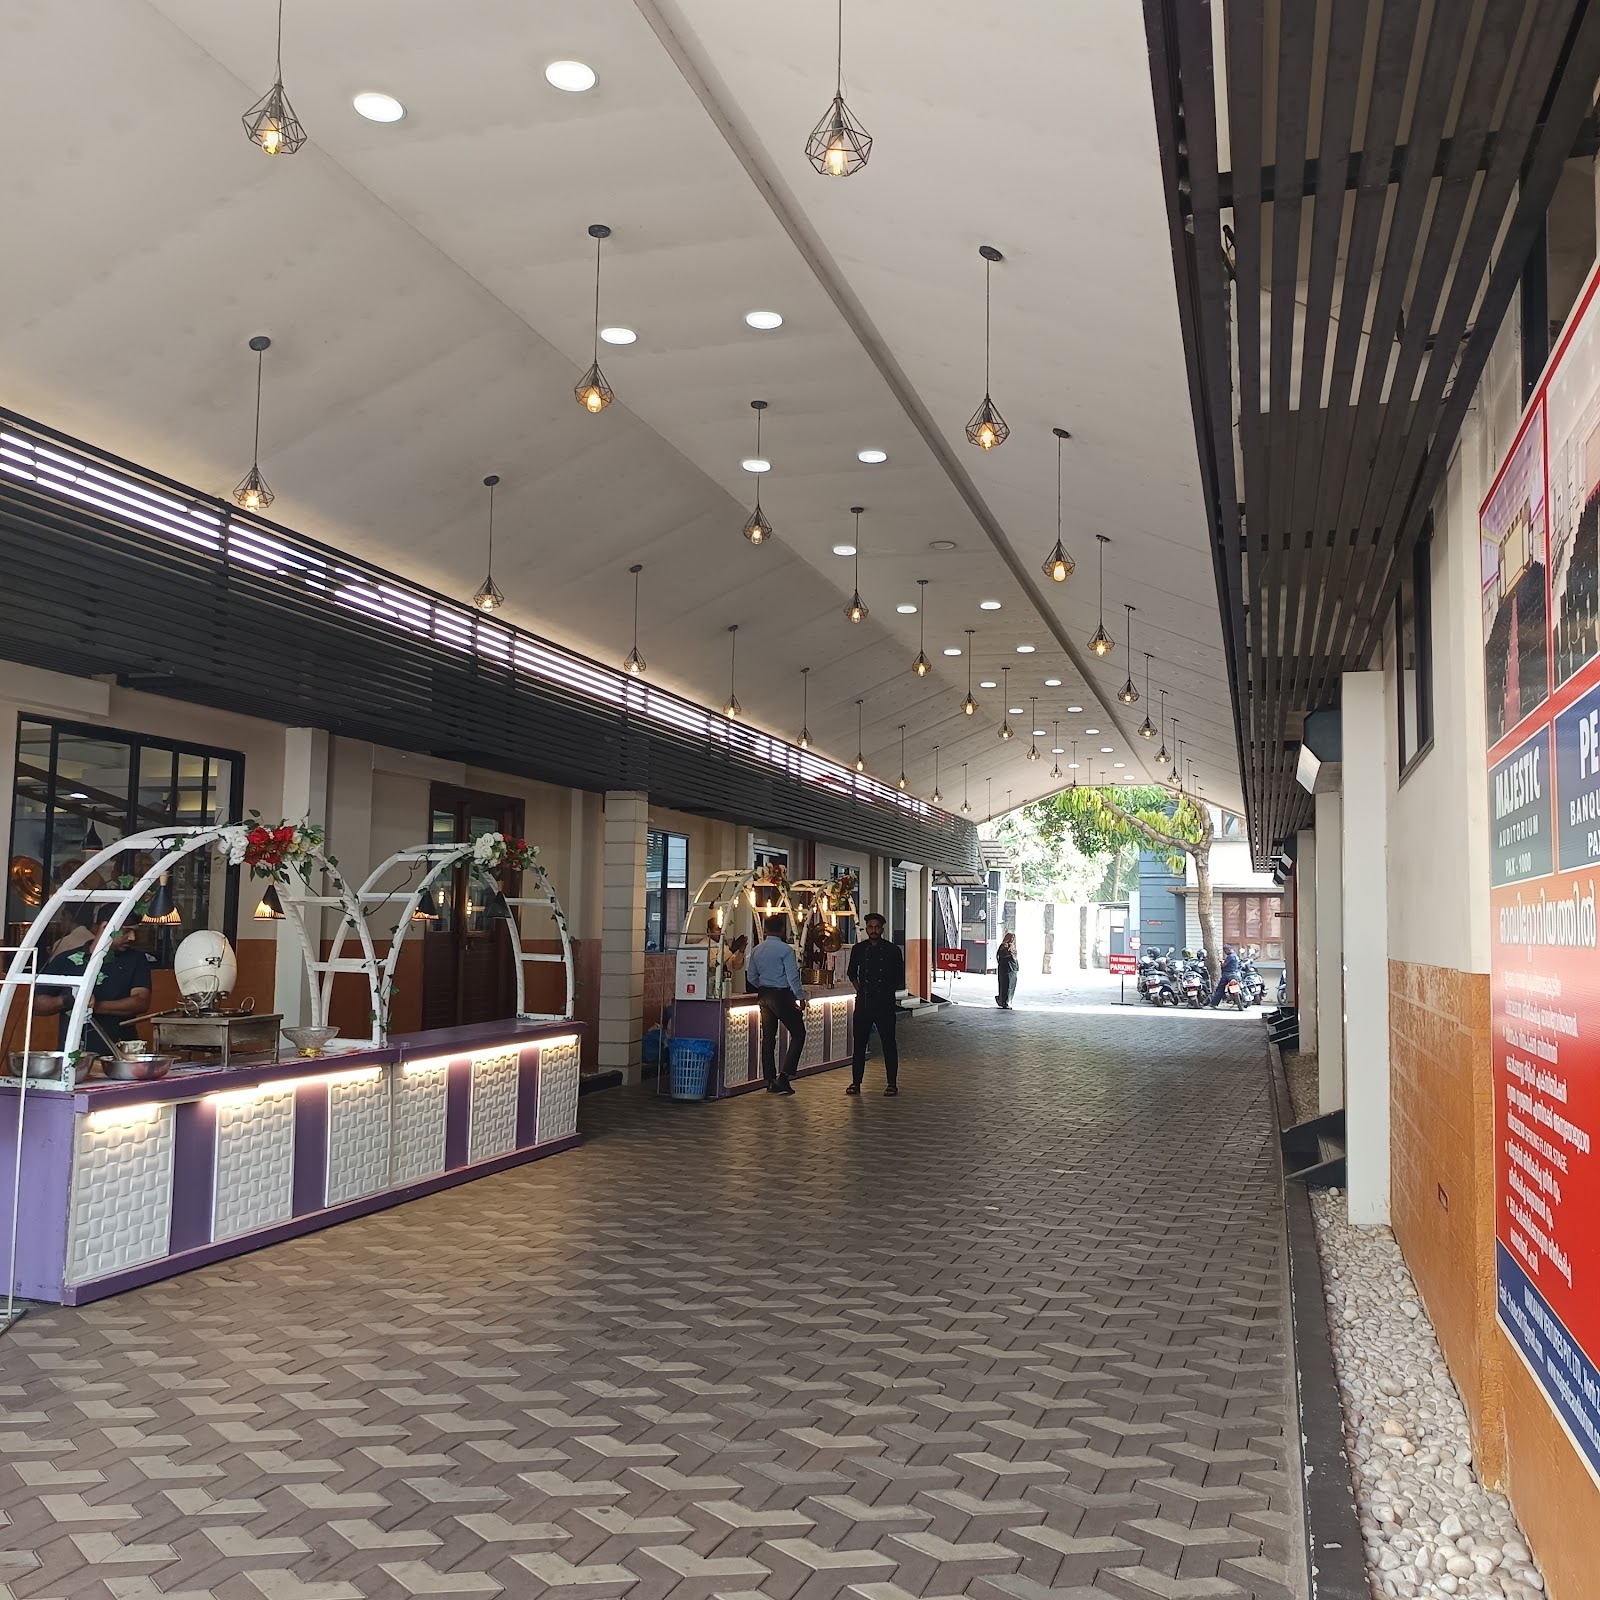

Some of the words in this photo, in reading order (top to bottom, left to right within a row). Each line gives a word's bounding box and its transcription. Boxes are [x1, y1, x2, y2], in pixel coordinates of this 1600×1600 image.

[1495, 746, 1541, 820] MAJESTIC
[1499, 814, 1539, 848] AUDITORIUM
[1505, 858, 1516, 877] PAX
[1519, 851, 1532, 872] 1000
[941, 953, 964, 961] TOILET
[1110, 963, 1135, 971] PARKING
